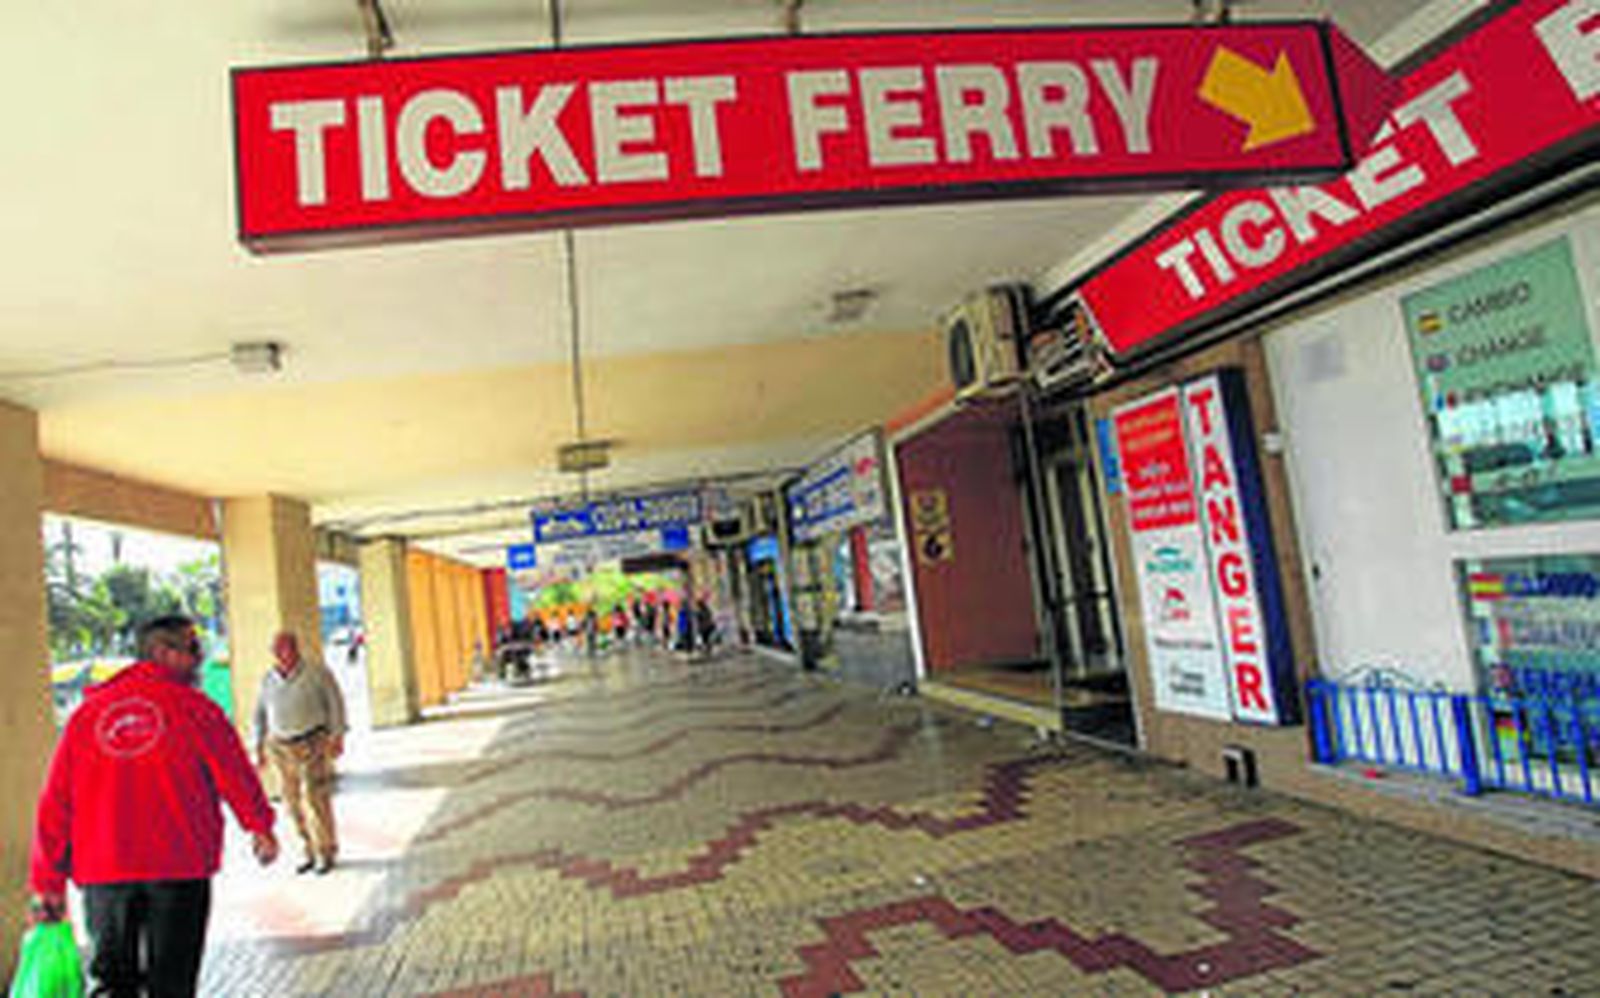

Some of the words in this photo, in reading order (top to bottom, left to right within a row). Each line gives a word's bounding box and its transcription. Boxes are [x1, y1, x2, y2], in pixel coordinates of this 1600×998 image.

[269, 75, 737, 206] TICKET
[785, 57, 1158, 170] FERRY
[1155, 70, 1478, 300] TICKET
[1448, 281, 1531, 324] CAMBIO
[1455, 324, 1545, 366] CHANGE
[1188, 387, 1268, 712] TANGER
